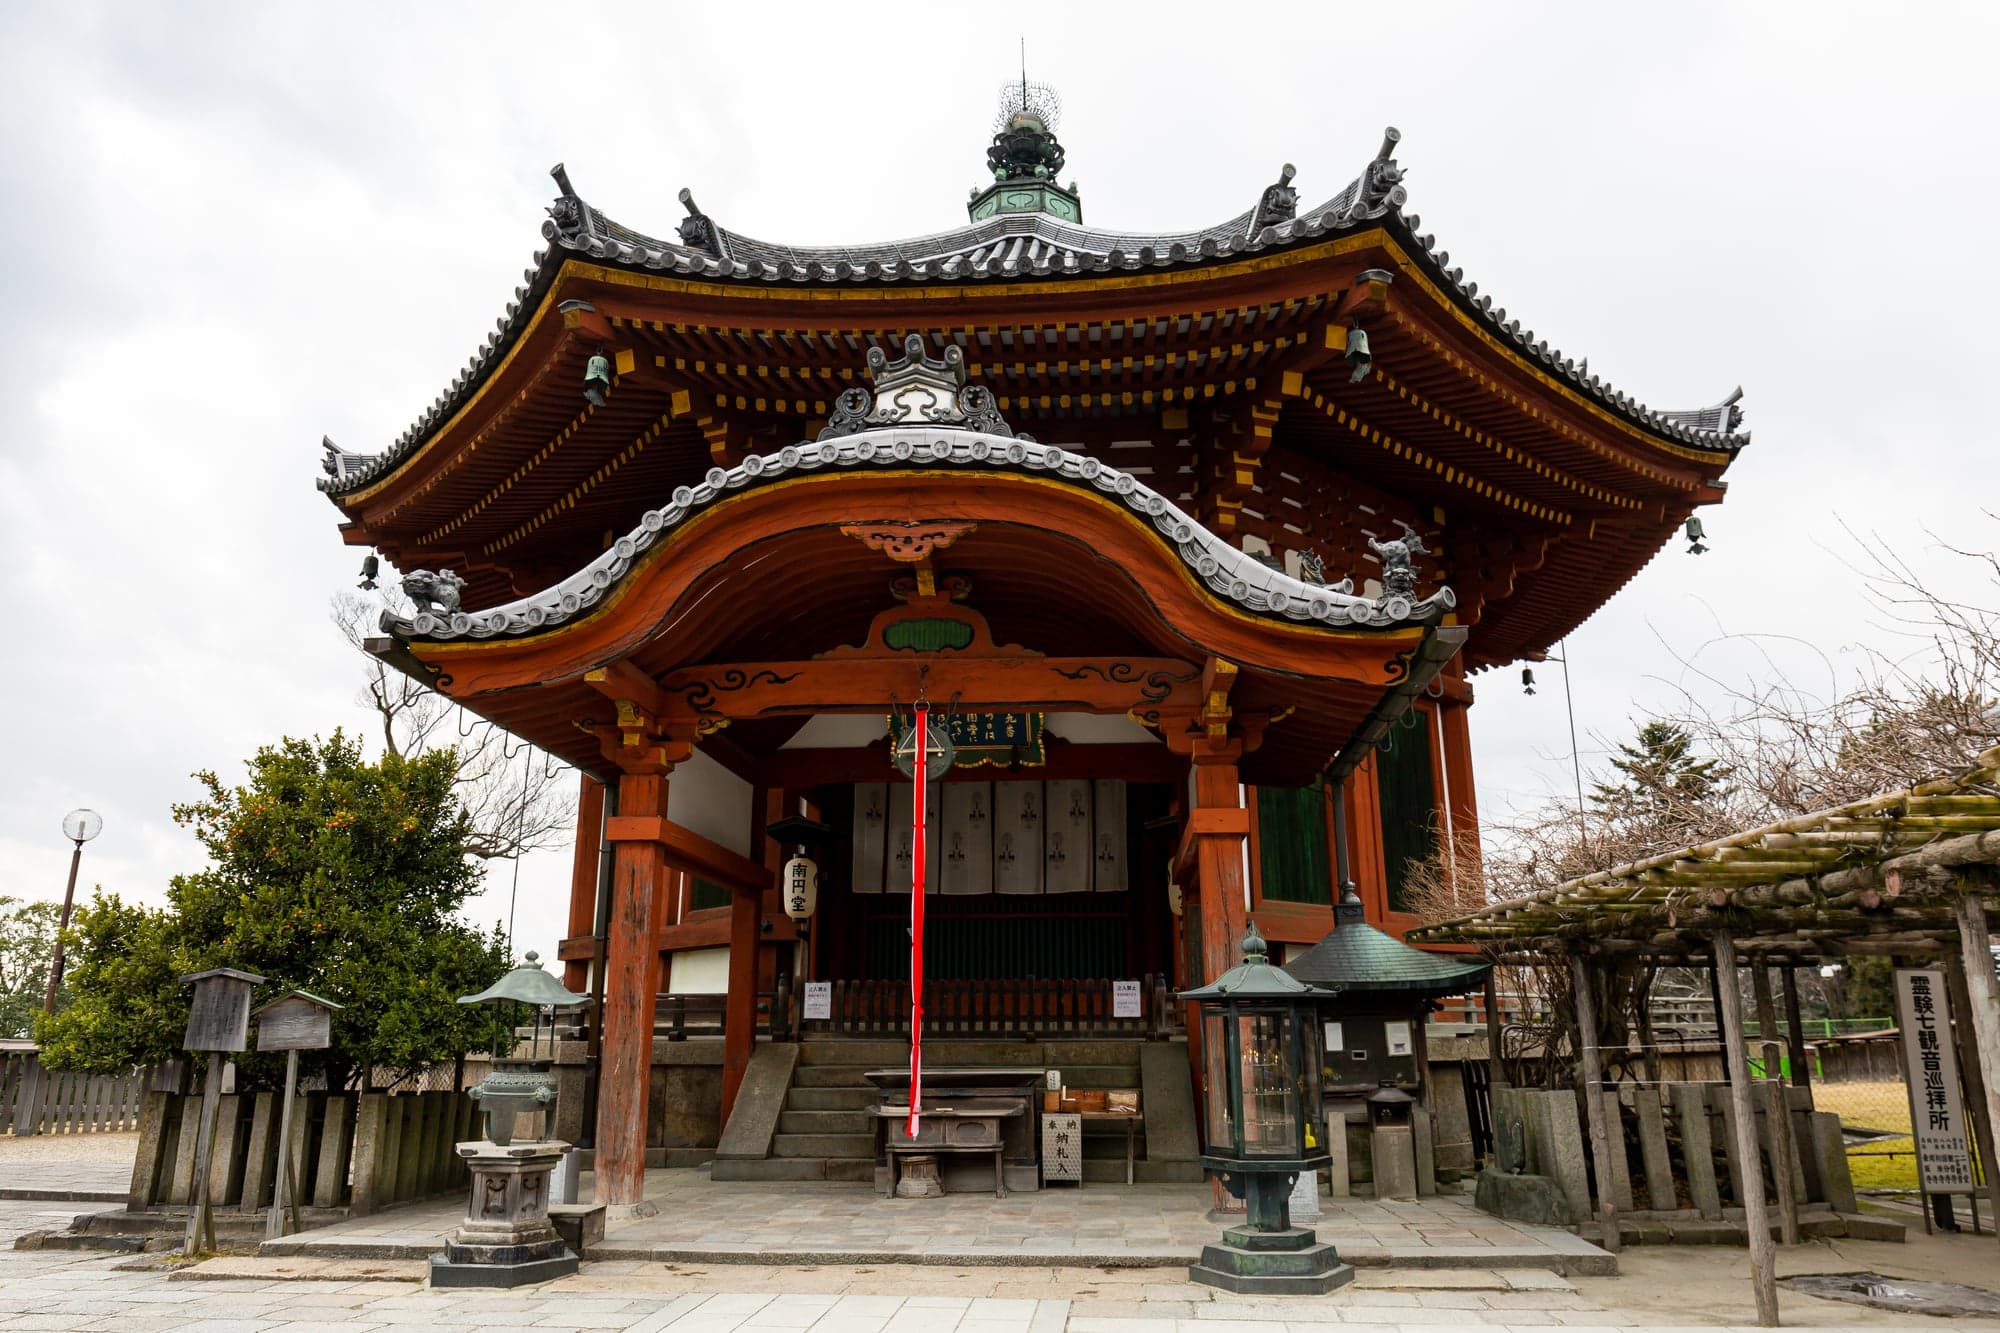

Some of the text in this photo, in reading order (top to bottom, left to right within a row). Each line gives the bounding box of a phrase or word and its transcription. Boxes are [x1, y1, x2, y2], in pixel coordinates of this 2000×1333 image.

[791, 863, 808, 912] 南円堂
[1910, 975, 1950, 1132] 霊験七観音巡拝所
